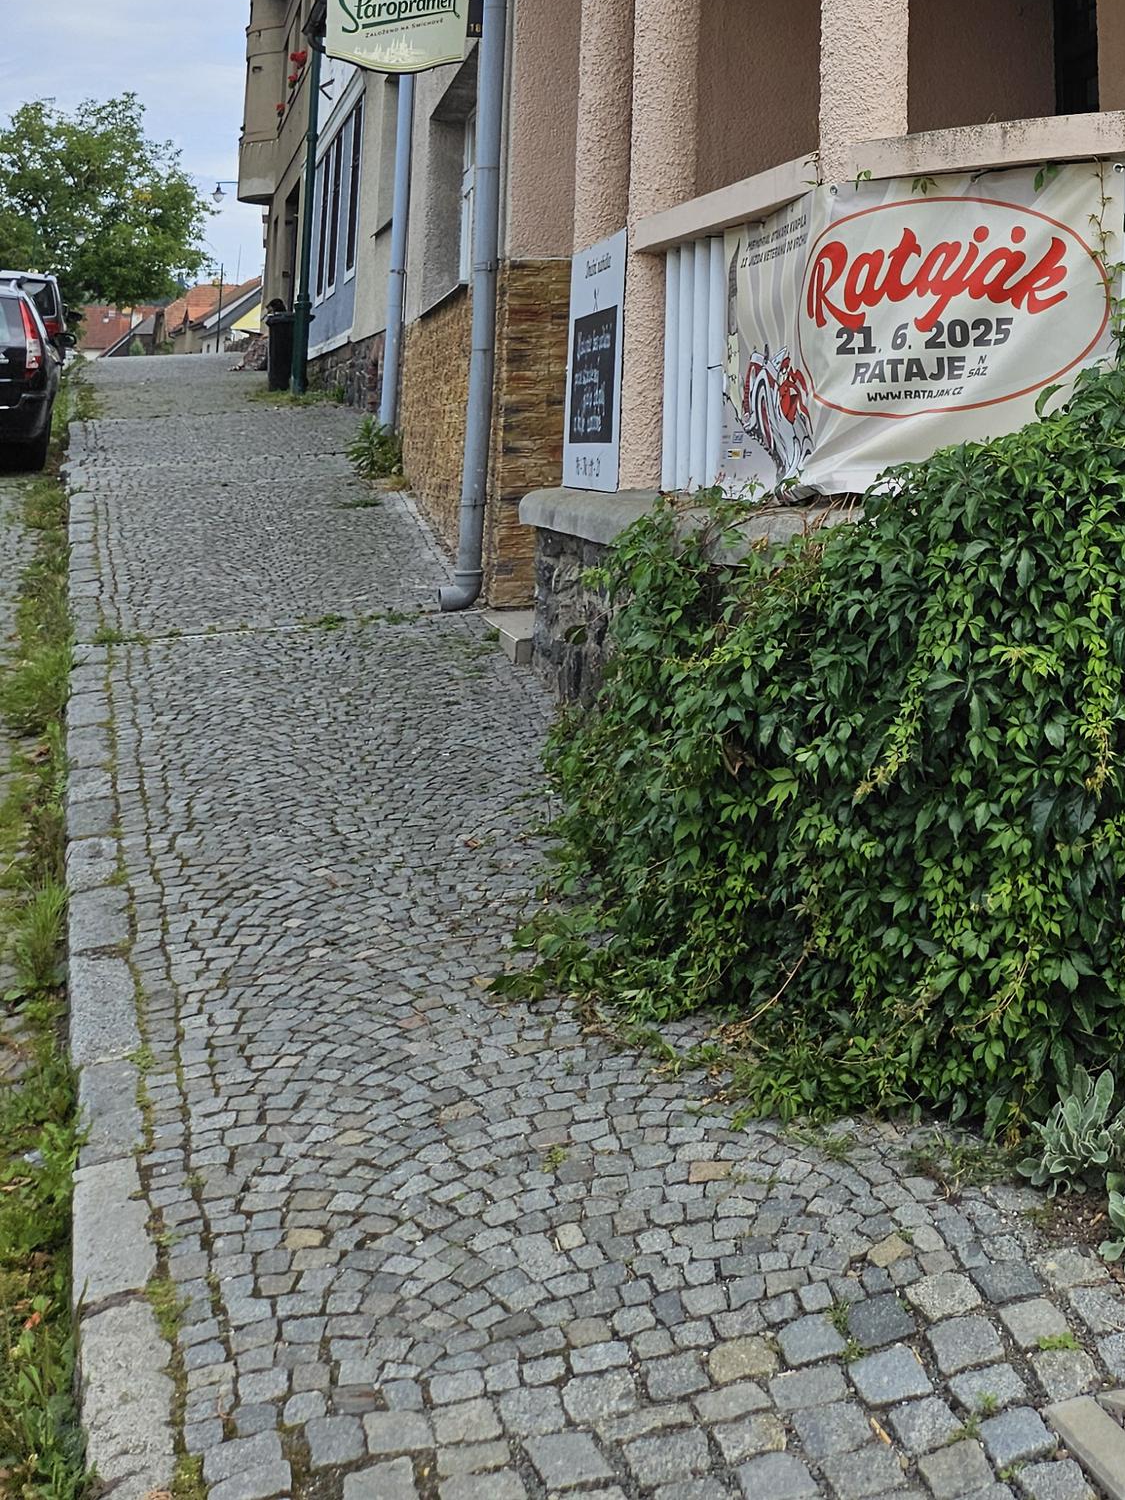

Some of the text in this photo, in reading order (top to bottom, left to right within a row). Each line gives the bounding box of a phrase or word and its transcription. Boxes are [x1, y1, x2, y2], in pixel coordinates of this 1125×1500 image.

[835, 317, 1014, 356] 21. 6. 2025
[851, 354, 988, 386] RATAJE N
[867, 386, 964, 402] WWW.RATAJAK.CZ
